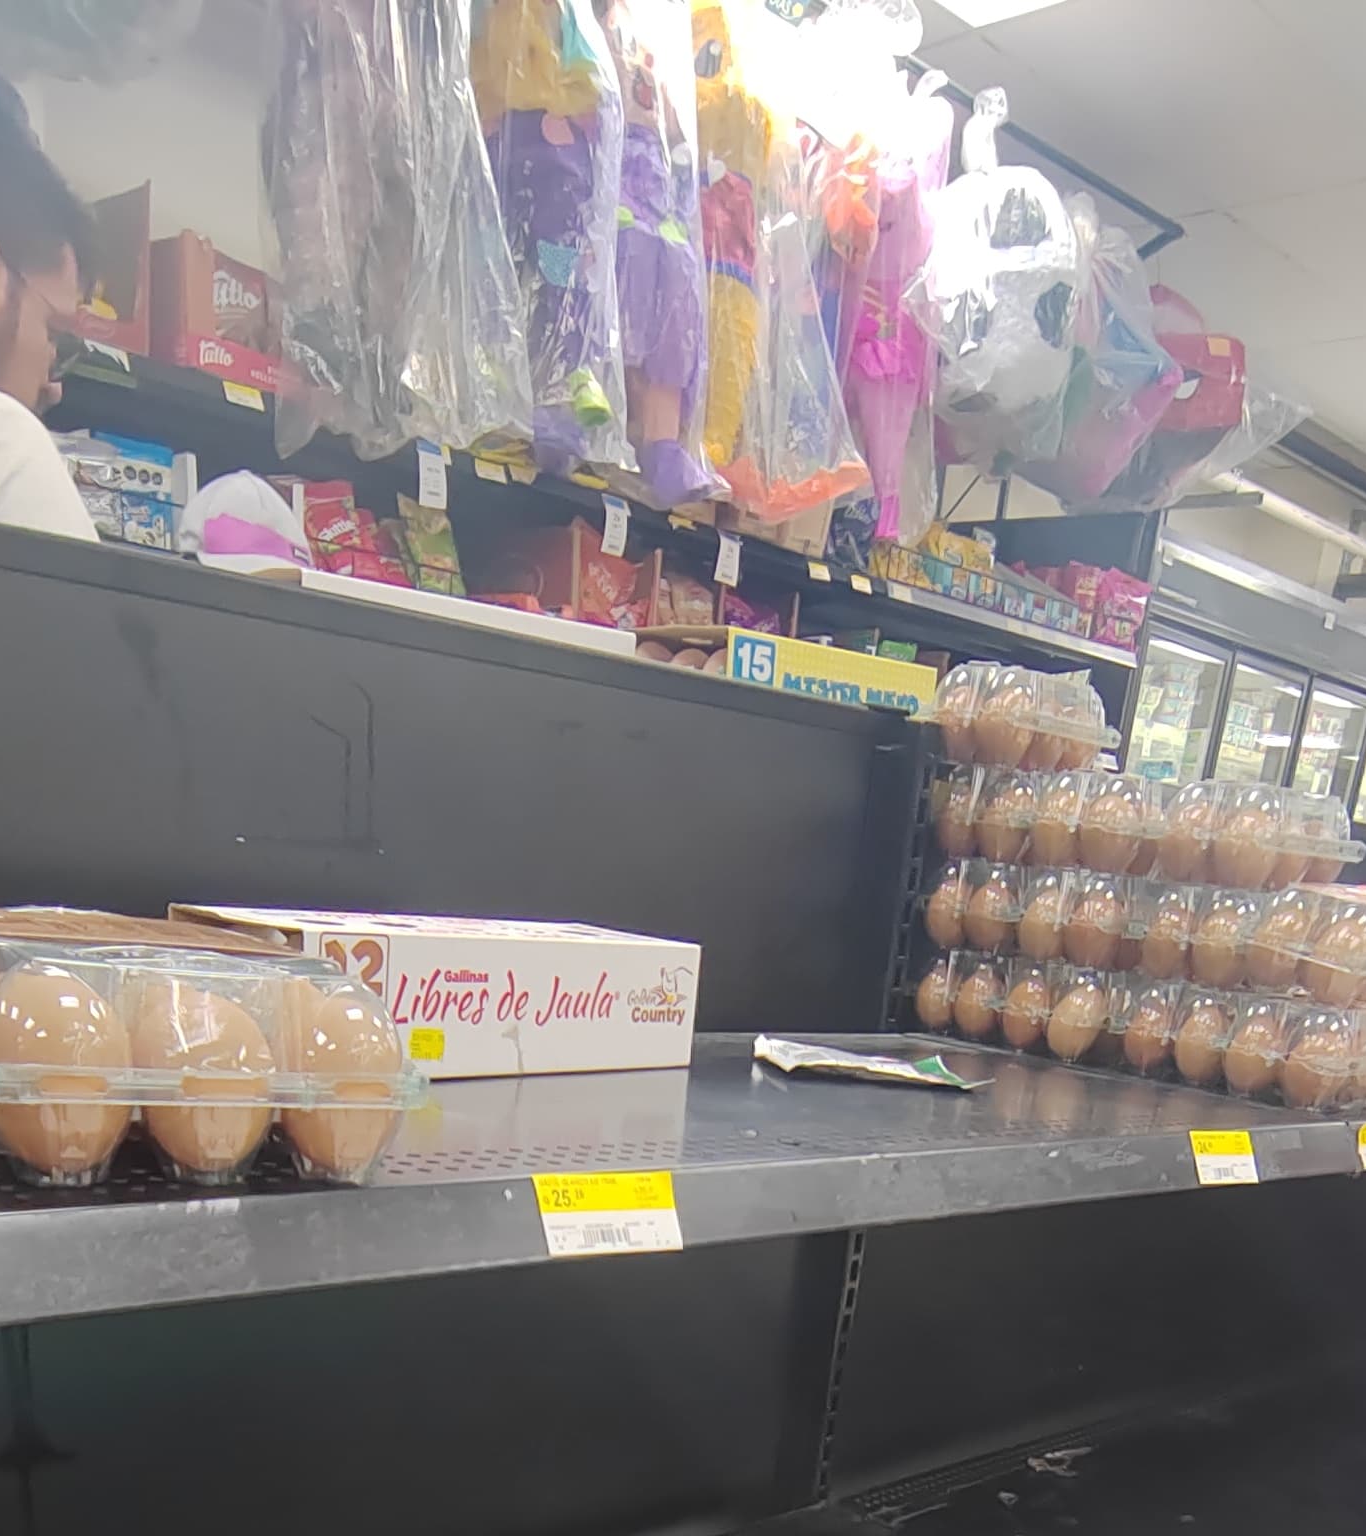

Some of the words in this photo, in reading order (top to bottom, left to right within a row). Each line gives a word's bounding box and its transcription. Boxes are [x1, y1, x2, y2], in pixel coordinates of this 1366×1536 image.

[737, 642, 773, 683] 15
[443, 969, 490, 984] Gallinas
[392, 967, 489, 1027] Libres
[496, 973, 530, 1022] de
[534, 971, 615, 1027] Jaula
[631, 1006, 686, 1027] Country
